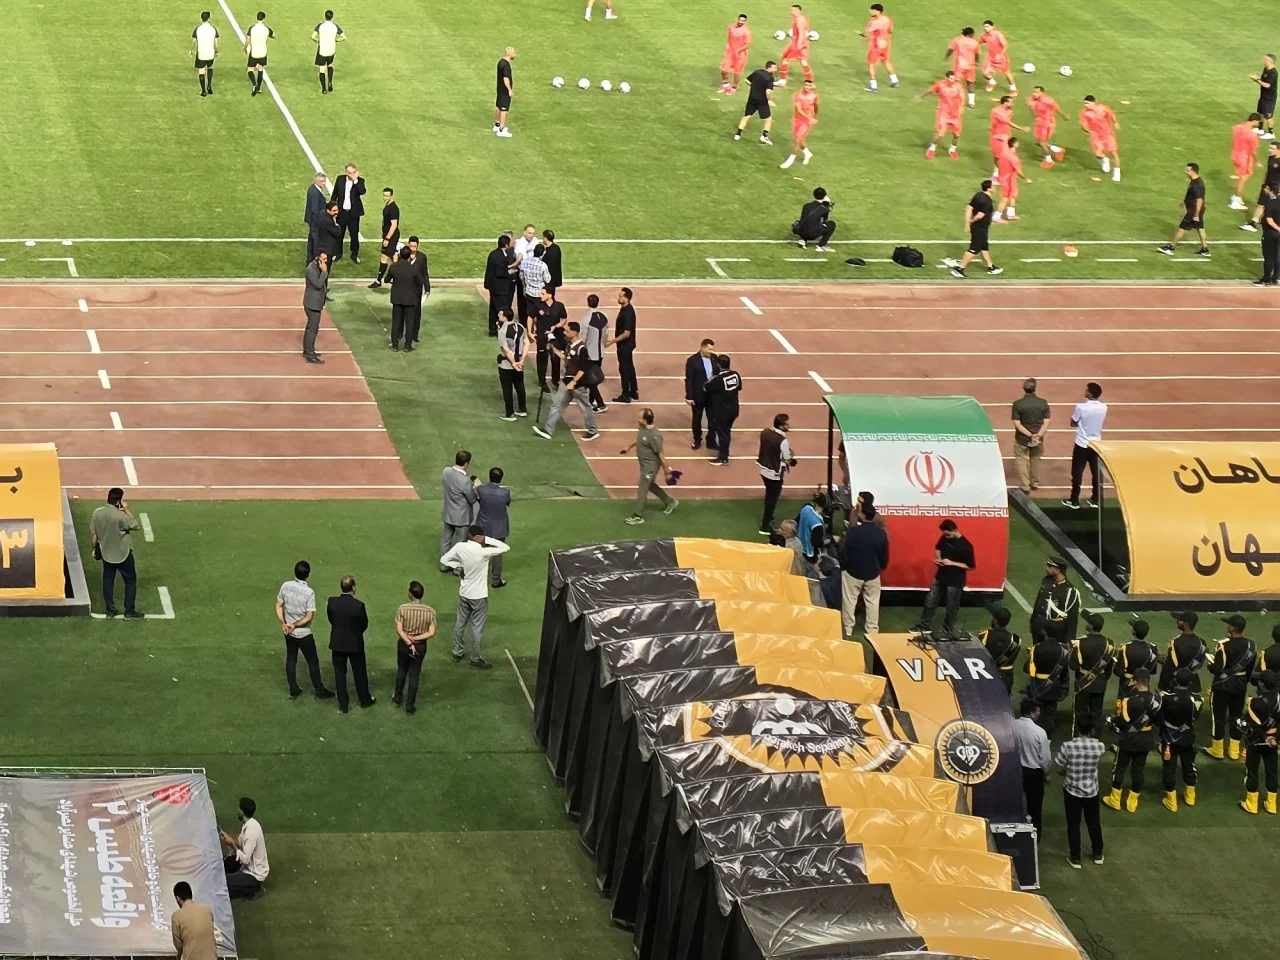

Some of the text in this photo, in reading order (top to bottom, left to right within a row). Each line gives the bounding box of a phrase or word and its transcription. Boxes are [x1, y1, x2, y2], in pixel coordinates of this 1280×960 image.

[1173, 456, 1280, 494] اهان
[896, 657, 994, 682] VAR
[87, 817, 133, 873] طبس
[89, 875, 146, 929] واقعه
